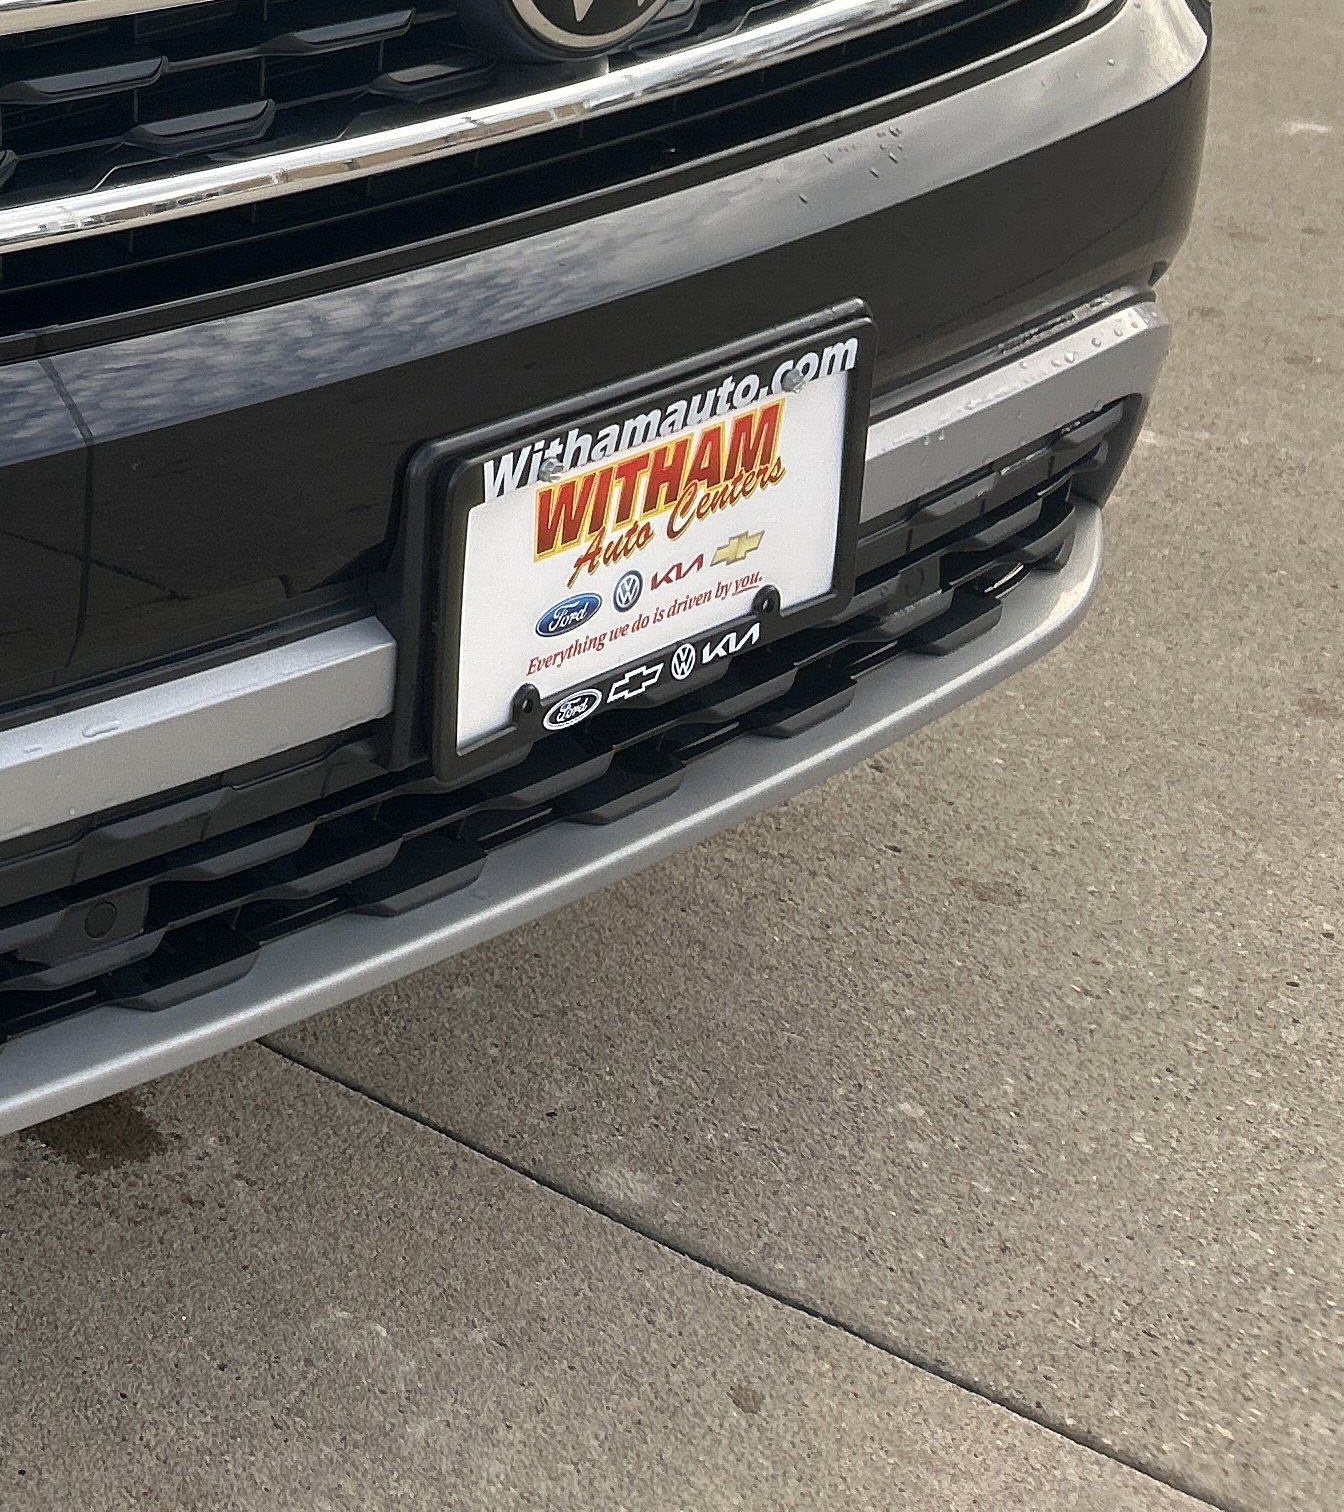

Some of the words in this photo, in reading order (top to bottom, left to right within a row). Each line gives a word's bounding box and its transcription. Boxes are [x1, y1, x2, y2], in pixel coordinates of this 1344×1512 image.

[534, 399, 784, 562] WITHAM
[567, 520, 655, 588] Auto
[666, 455, 787, 541] Centers
[526, 631, 608, 676] Everything
[609, 624, 630, 642] we
[632, 614, 650, 633] do
[653, 606, 664, 624] is
[667, 590, 713, 619] driven
[715, 581, 733, 601] by
[733, 571, 764, 594] you.
[650, 553, 704, 591] KIA
[702, 622, 761, 665] KIA
